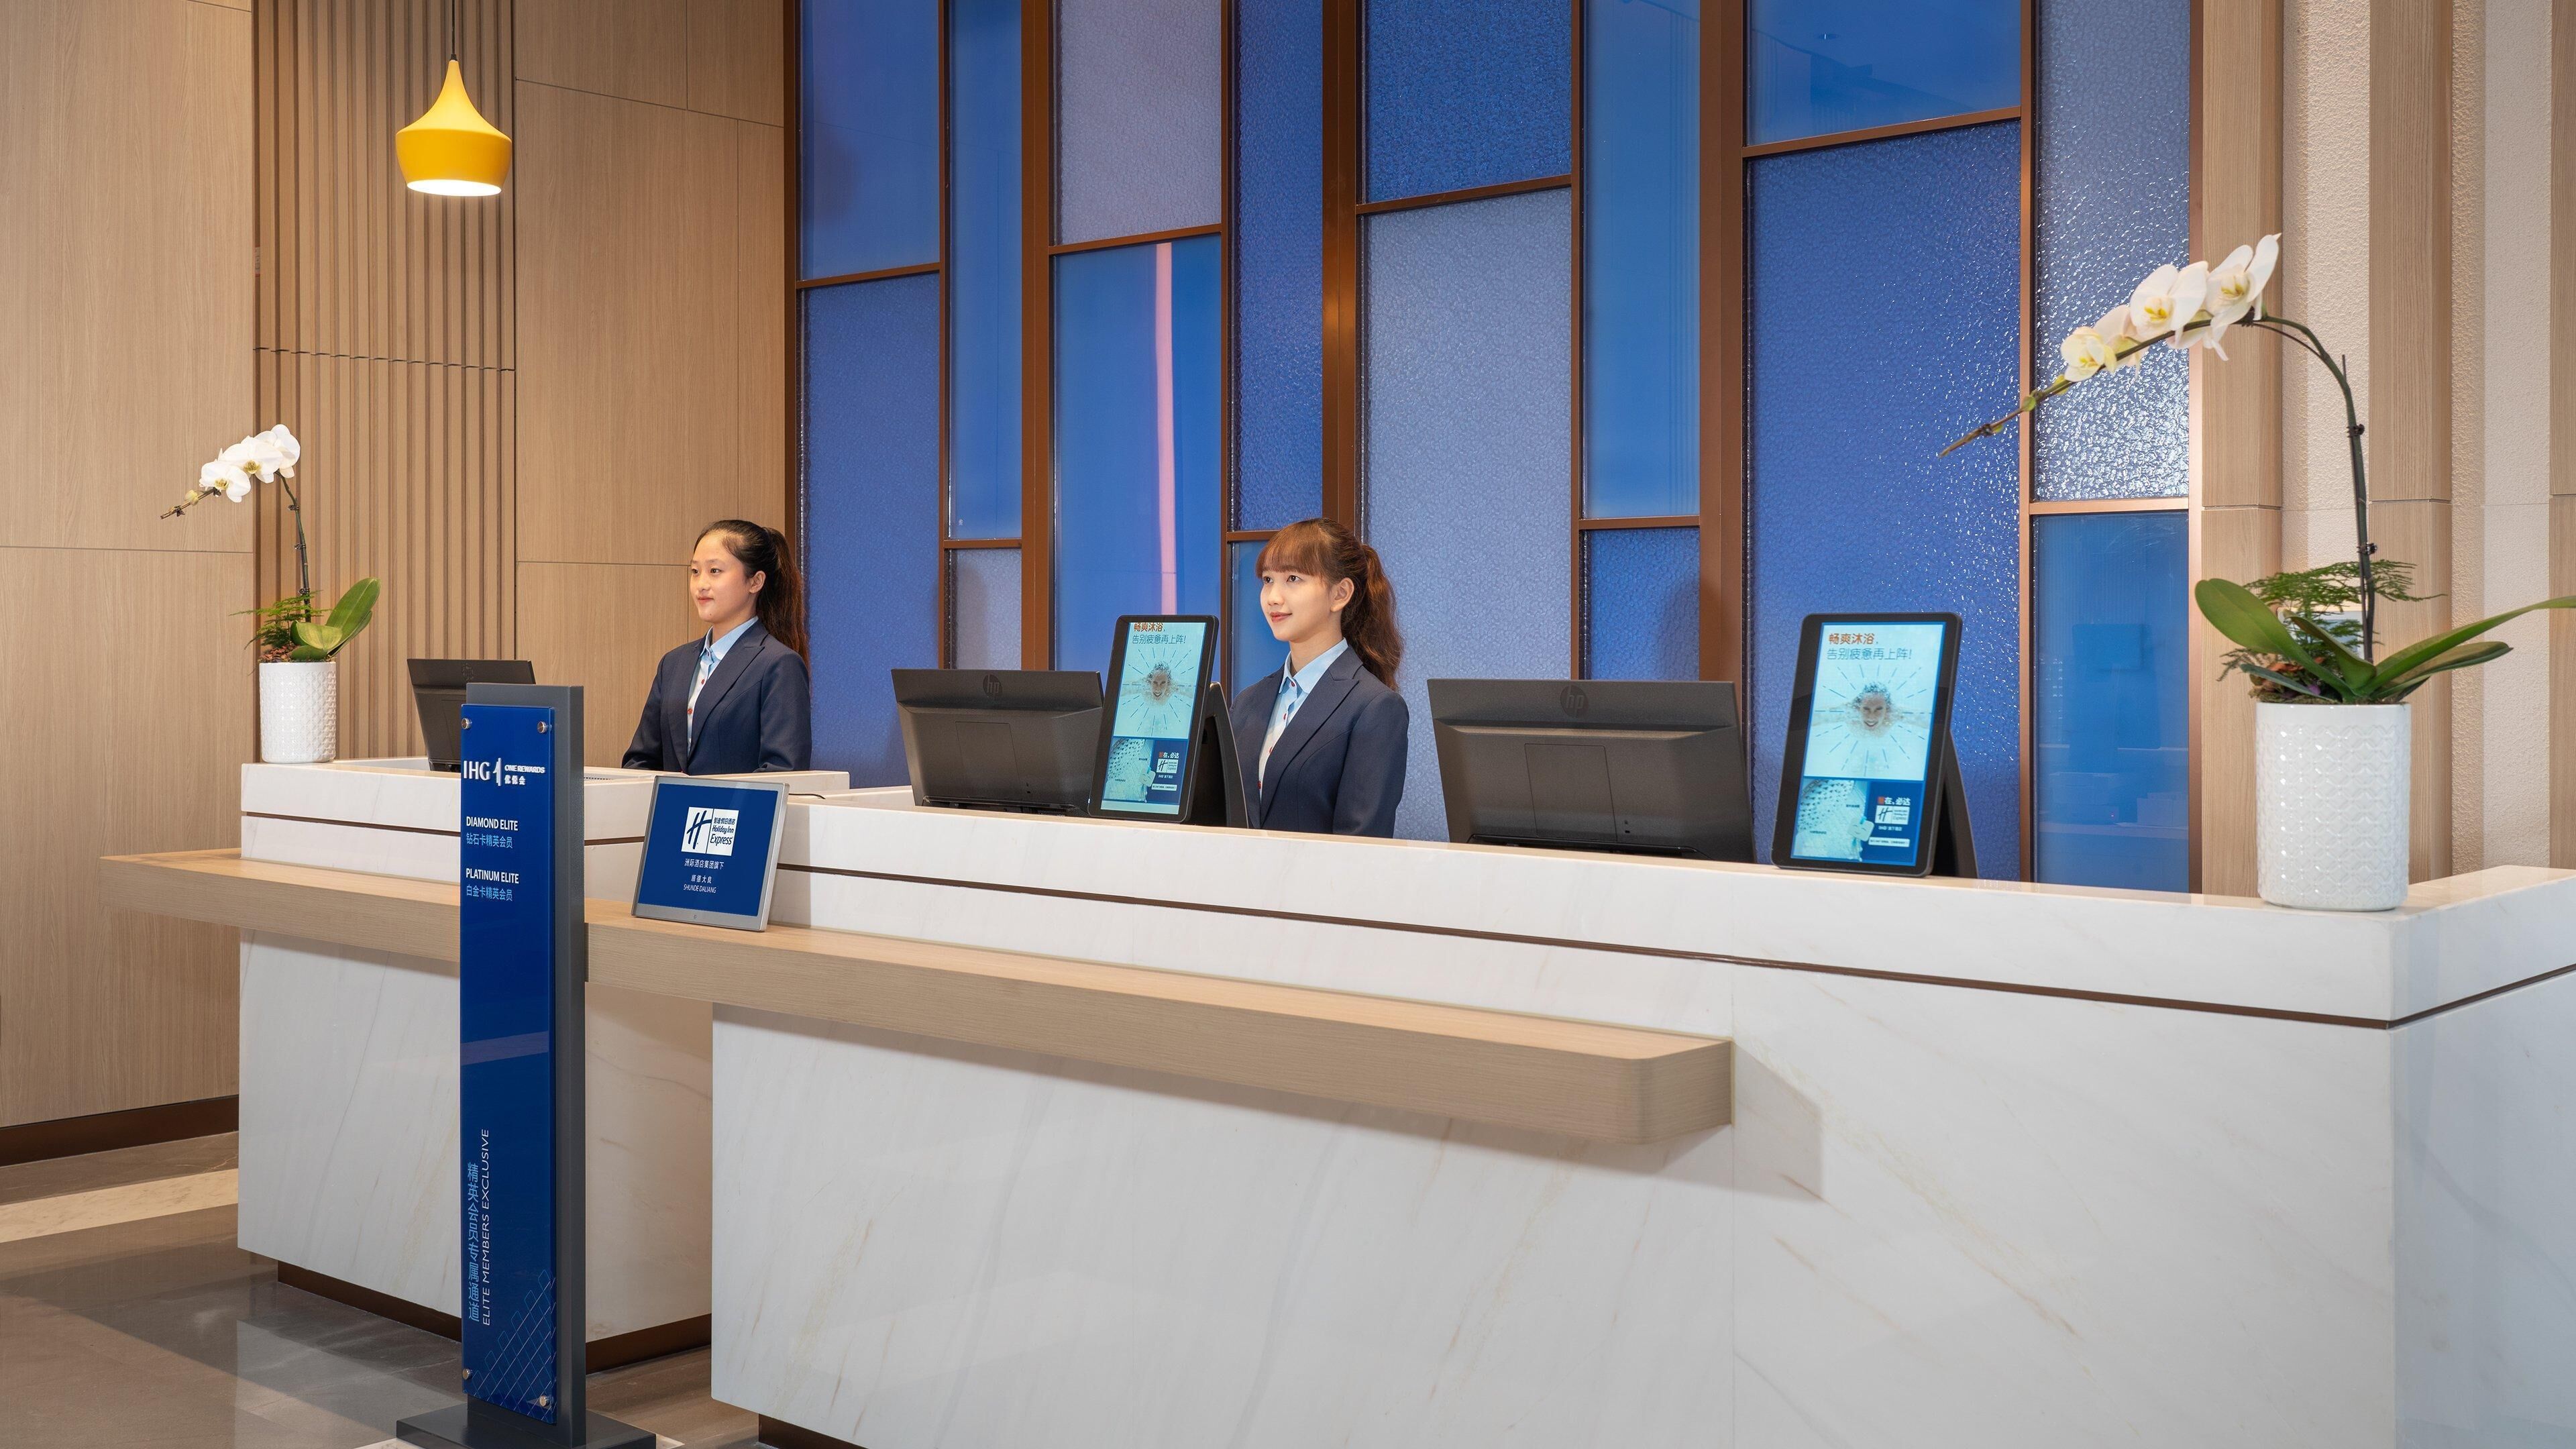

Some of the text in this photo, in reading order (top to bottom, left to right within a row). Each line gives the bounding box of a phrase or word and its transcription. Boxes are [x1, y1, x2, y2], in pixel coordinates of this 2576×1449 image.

[464, 761, 490, 780] IHG
[517, 765, 545, 774] REWARDS
[466, 816, 519, 831] DIAMOND ELITE
[712, 824, 728, 835] Holiday
[466, 832, 513, 849] 钻石卡精英会员
[710, 833, 733, 847] Express
[466, 867, 519, 884] PLATINUM ELITE
[466, 884, 513, 902] 白金卡精英会员
[683, 883, 700, 892] SHUNDE
[481, 1128, 490, 1326] ELITE MEMBERS EXCLUSIVE
[468, 1161, 480, 1322] 精英会员专属通道
